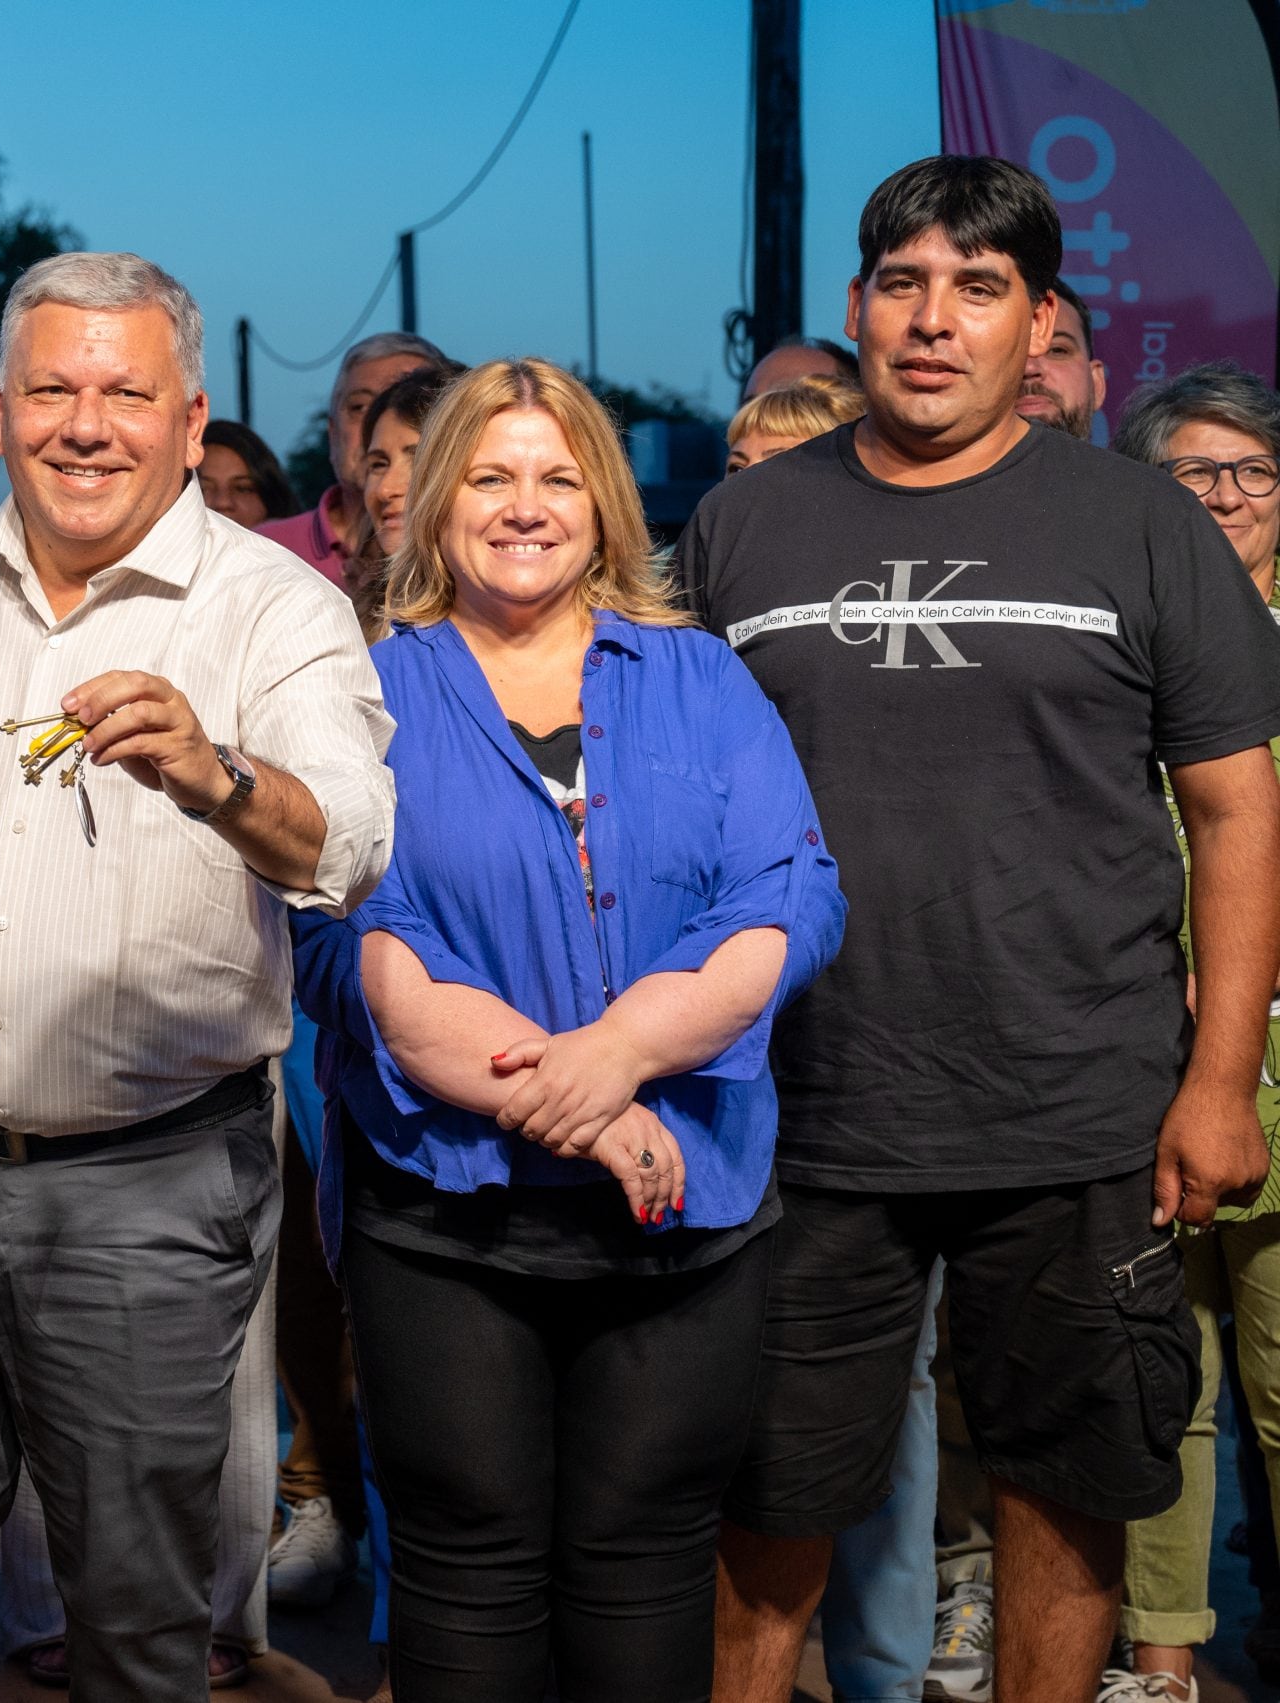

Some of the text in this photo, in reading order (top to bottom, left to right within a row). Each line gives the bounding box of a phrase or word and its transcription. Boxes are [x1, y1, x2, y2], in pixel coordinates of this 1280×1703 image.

[734, 622, 761, 640] Calvin
[871, 606, 914, 618] Calvin
[918, 606, 949, 618] Klein
[951, 605, 995, 618] Calvin
[998, 606, 1031, 619] Klein
[1034, 608, 1076, 623] Calvin
[1080, 613, 1110, 628] Klein
